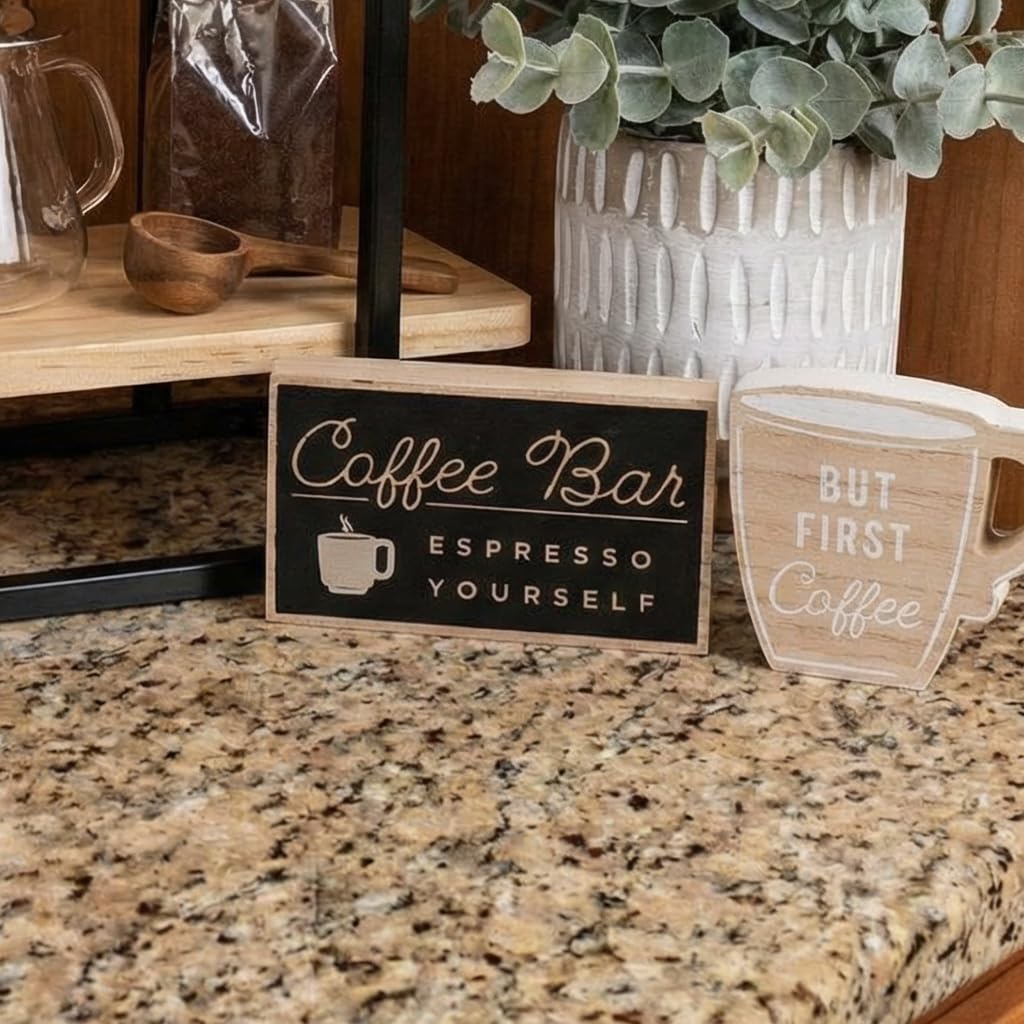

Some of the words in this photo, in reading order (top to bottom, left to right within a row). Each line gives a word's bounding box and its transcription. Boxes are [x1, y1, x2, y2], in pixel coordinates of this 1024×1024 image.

[291, 417, 499, 511] Coffee
[525, 429, 687, 508] Bar
[819, 464, 897, 511] BUT
[429, 535, 653, 570] ESPRESSO
[795, 511, 912, 563] FIRST
[428, 578, 656, 614] YOURSELF
[769, 560, 923, 639] Coffee
